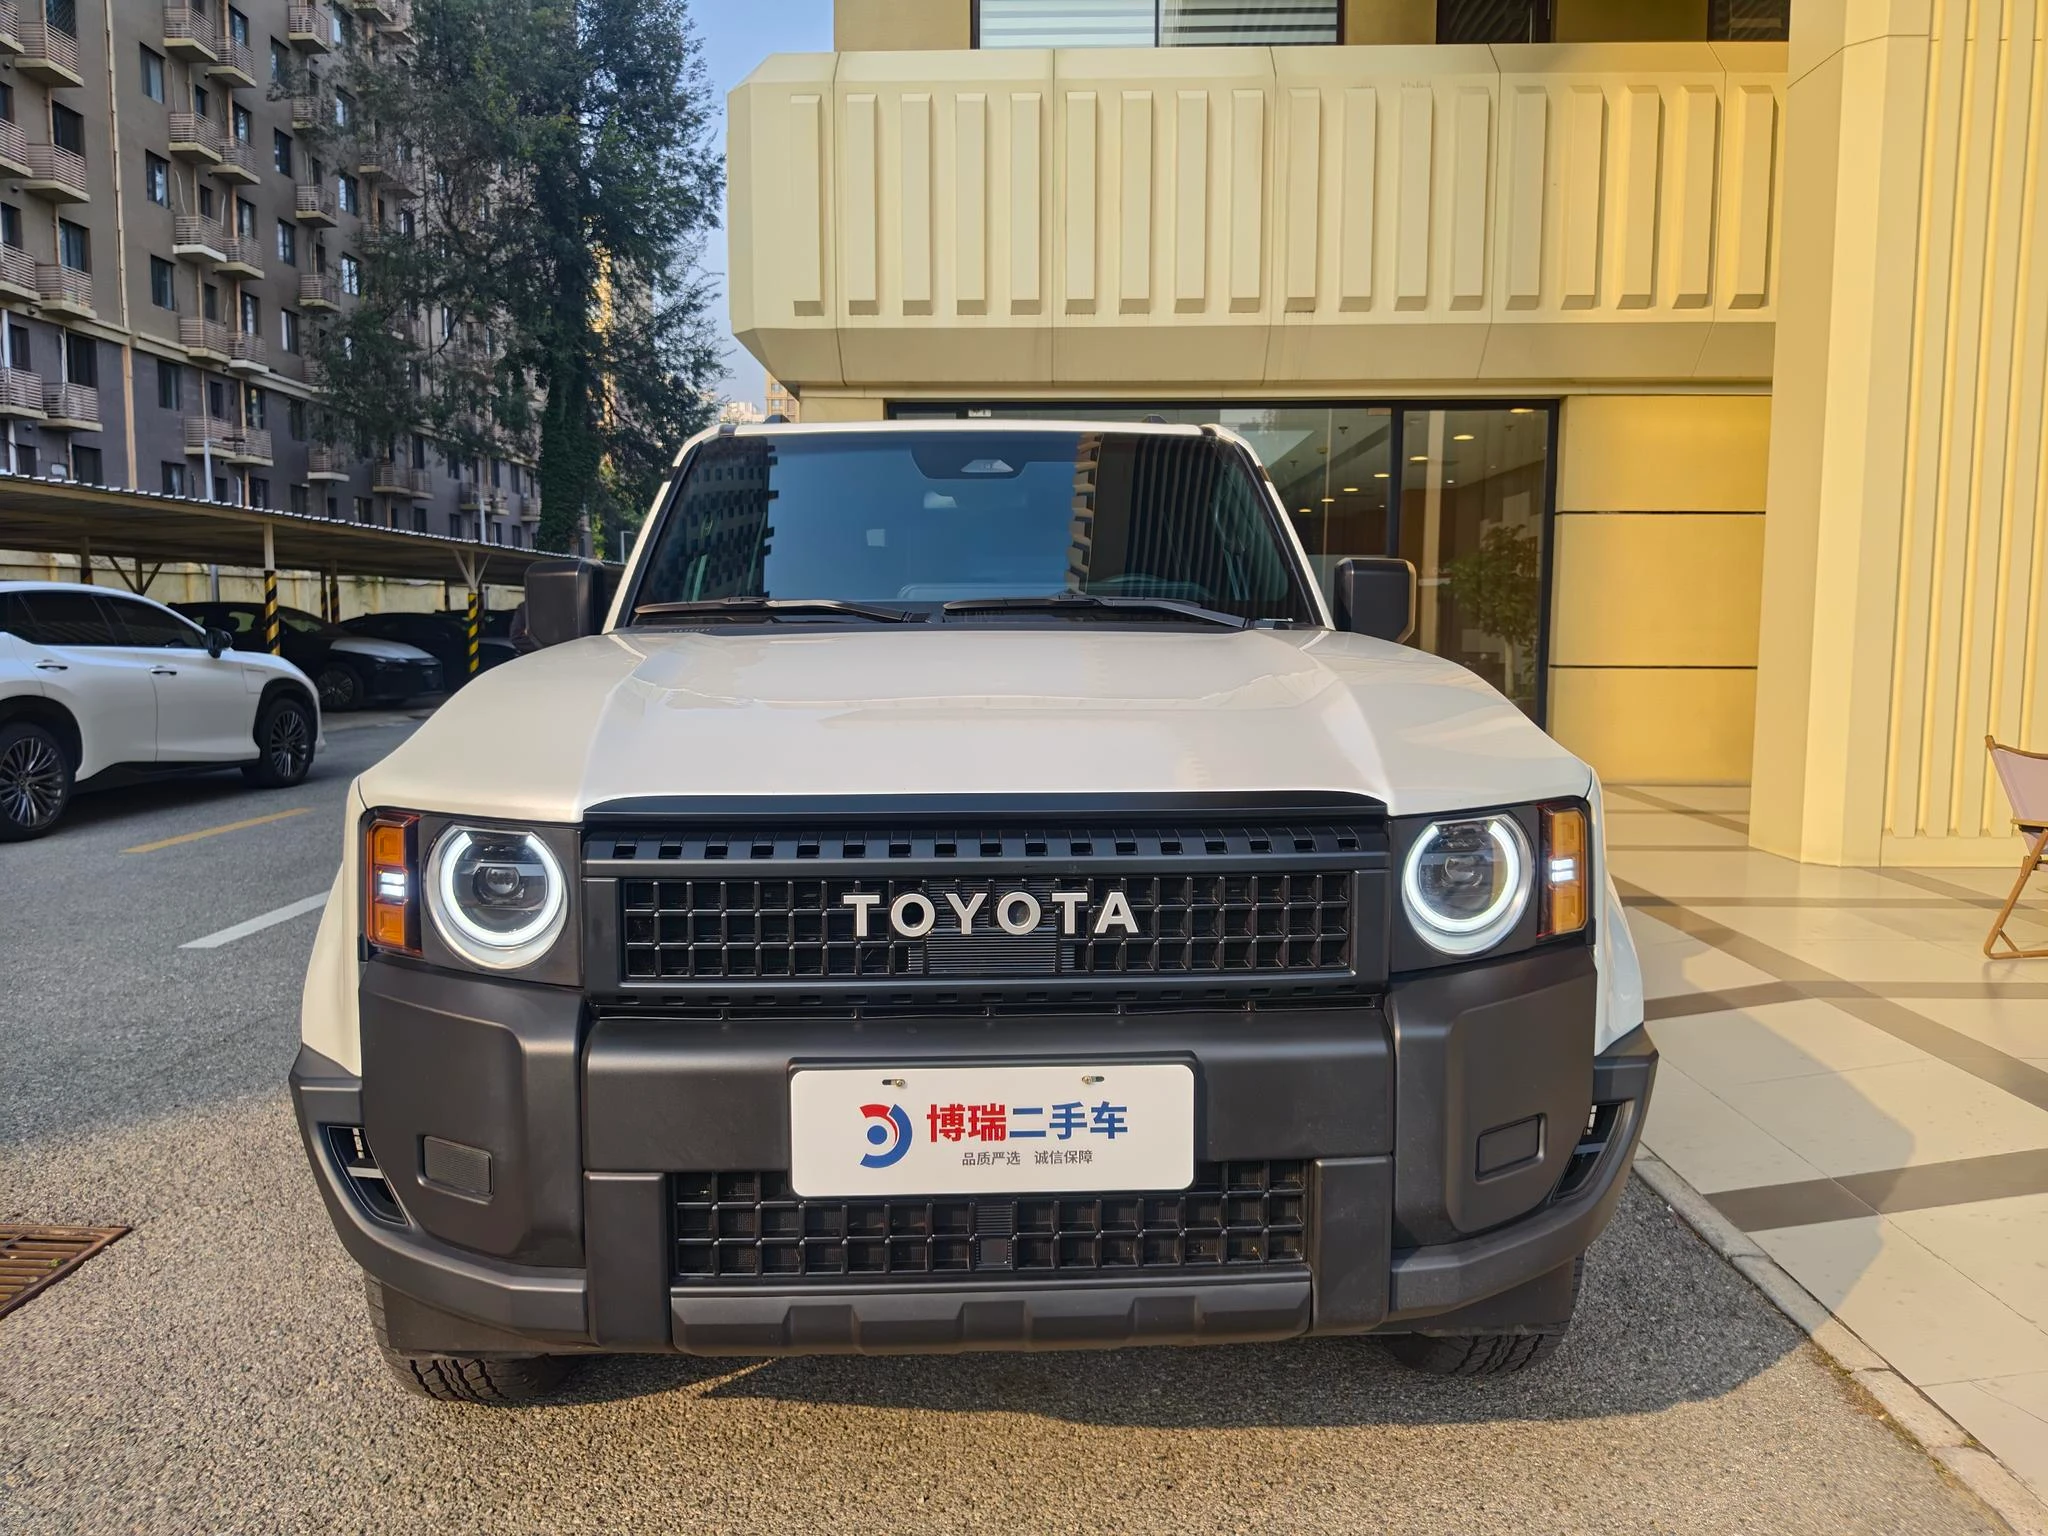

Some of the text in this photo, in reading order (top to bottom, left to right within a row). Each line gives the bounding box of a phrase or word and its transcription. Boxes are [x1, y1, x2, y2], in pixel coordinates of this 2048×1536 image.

[842, 891, 1139, 938] TOYOTA
[926, 1101, 1129, 1143] 博瑞二手车
[962, 1149, 1093, 1166] 品质严选 诚信保障
